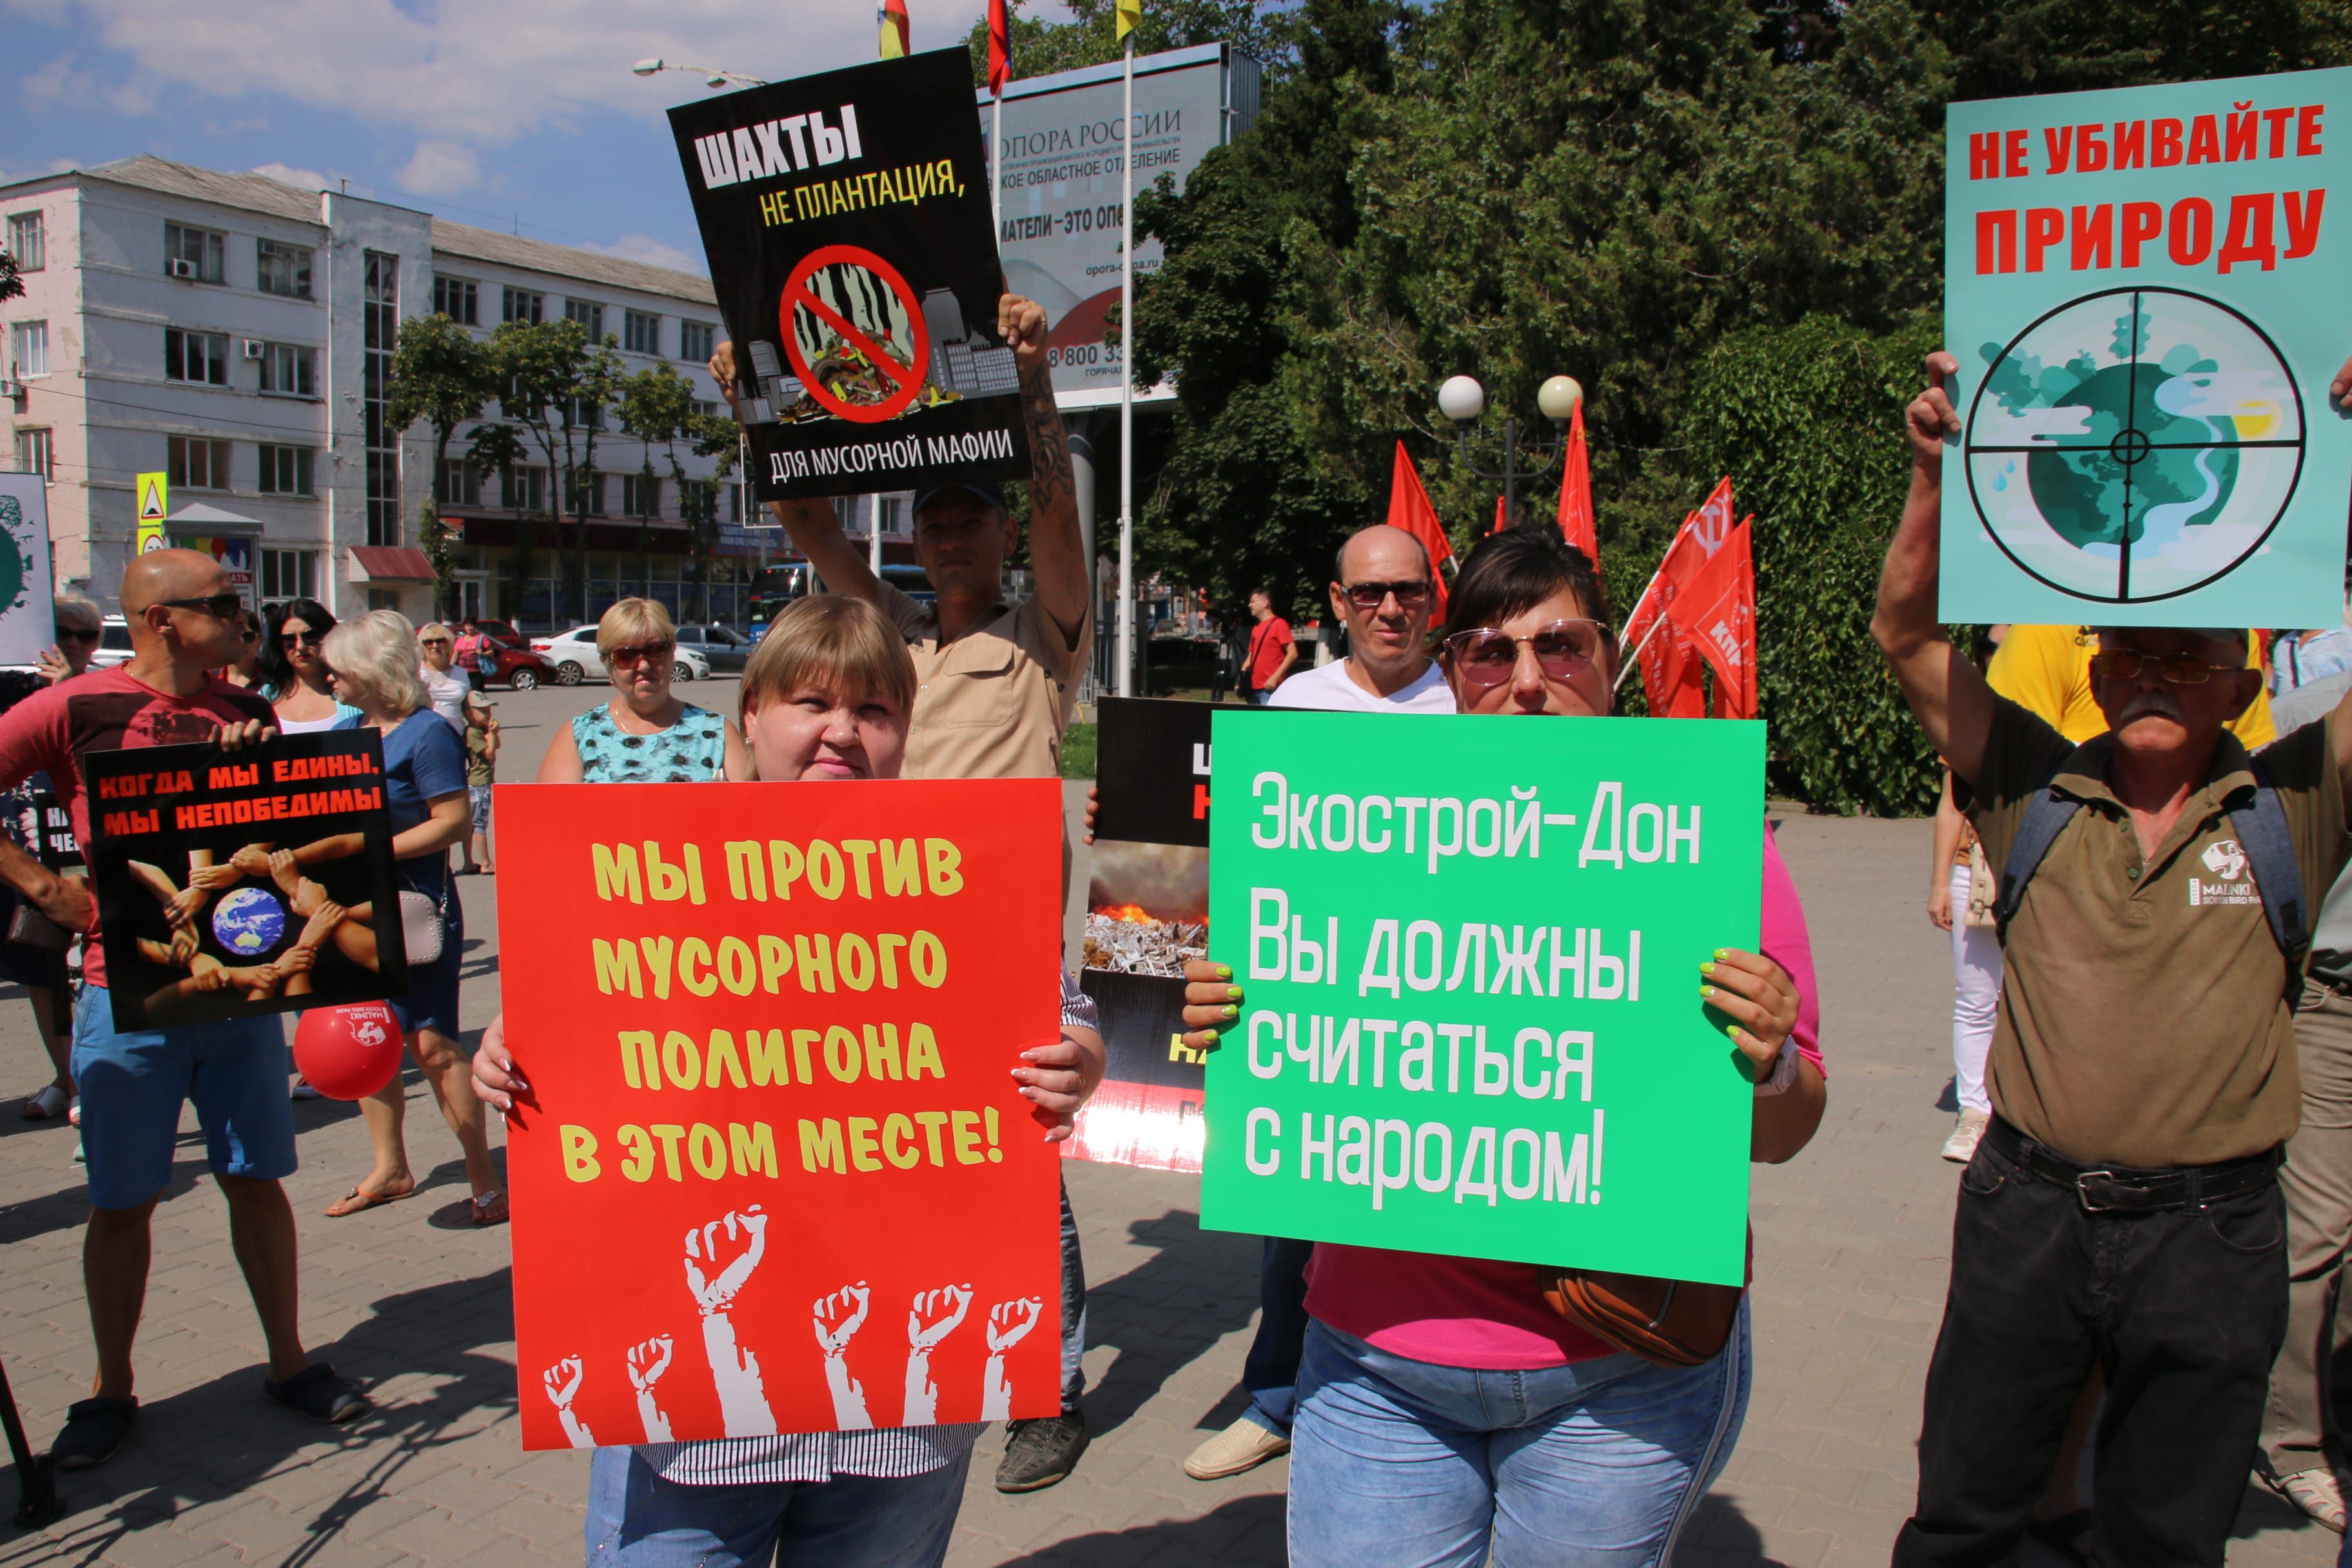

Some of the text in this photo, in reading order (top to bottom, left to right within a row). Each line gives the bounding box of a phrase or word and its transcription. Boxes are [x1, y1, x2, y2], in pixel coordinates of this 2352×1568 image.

[694, 104, 862, 189] ШАХТЫ
[1028, 161, 1101, 186] ОБЛАСТНОЕ
[1970, 100, 2324, 181] НЕ УБИВАЙТЕ
[760, 159, 965, 226] НЕ ПЛАНТАЦИЯ,
[1976, 189, 2326, 275] ПРИРОДУ
[1049, 348, 1059, 368] 8
[1064, 346, 1097, 366] 800
[770, 429, 1014, 485] ДЛЯ МУСОРНОЙ МАФИИ
[99, 752, 379, 799] КОГДА МЫ ЕДИНЫ,
[103, 787, 382, 836] МЫ НЕПОБЕДИМЫ
[1251, 771, 1702, 876] Экострой-Дон
[591, 838, 964, 905] МЫ ПРОТИВ
[2229, 896, 2248, 905] BIRD
[2249, 896, 2261, 904] PAR
[592, 930, 948, 1001] МУСОРНОГО
[1249, 887, 1642, 1003] Вы должны
[618, 1022, 945, 1091] ПОЛИГОНА
[1248, 1010, 1595, 1102] считаться
[559, 1106, 1004, 1183] В ЭТОМ МЕСТЕ!
[1245, 1107, 1605, 1211] с народом!
